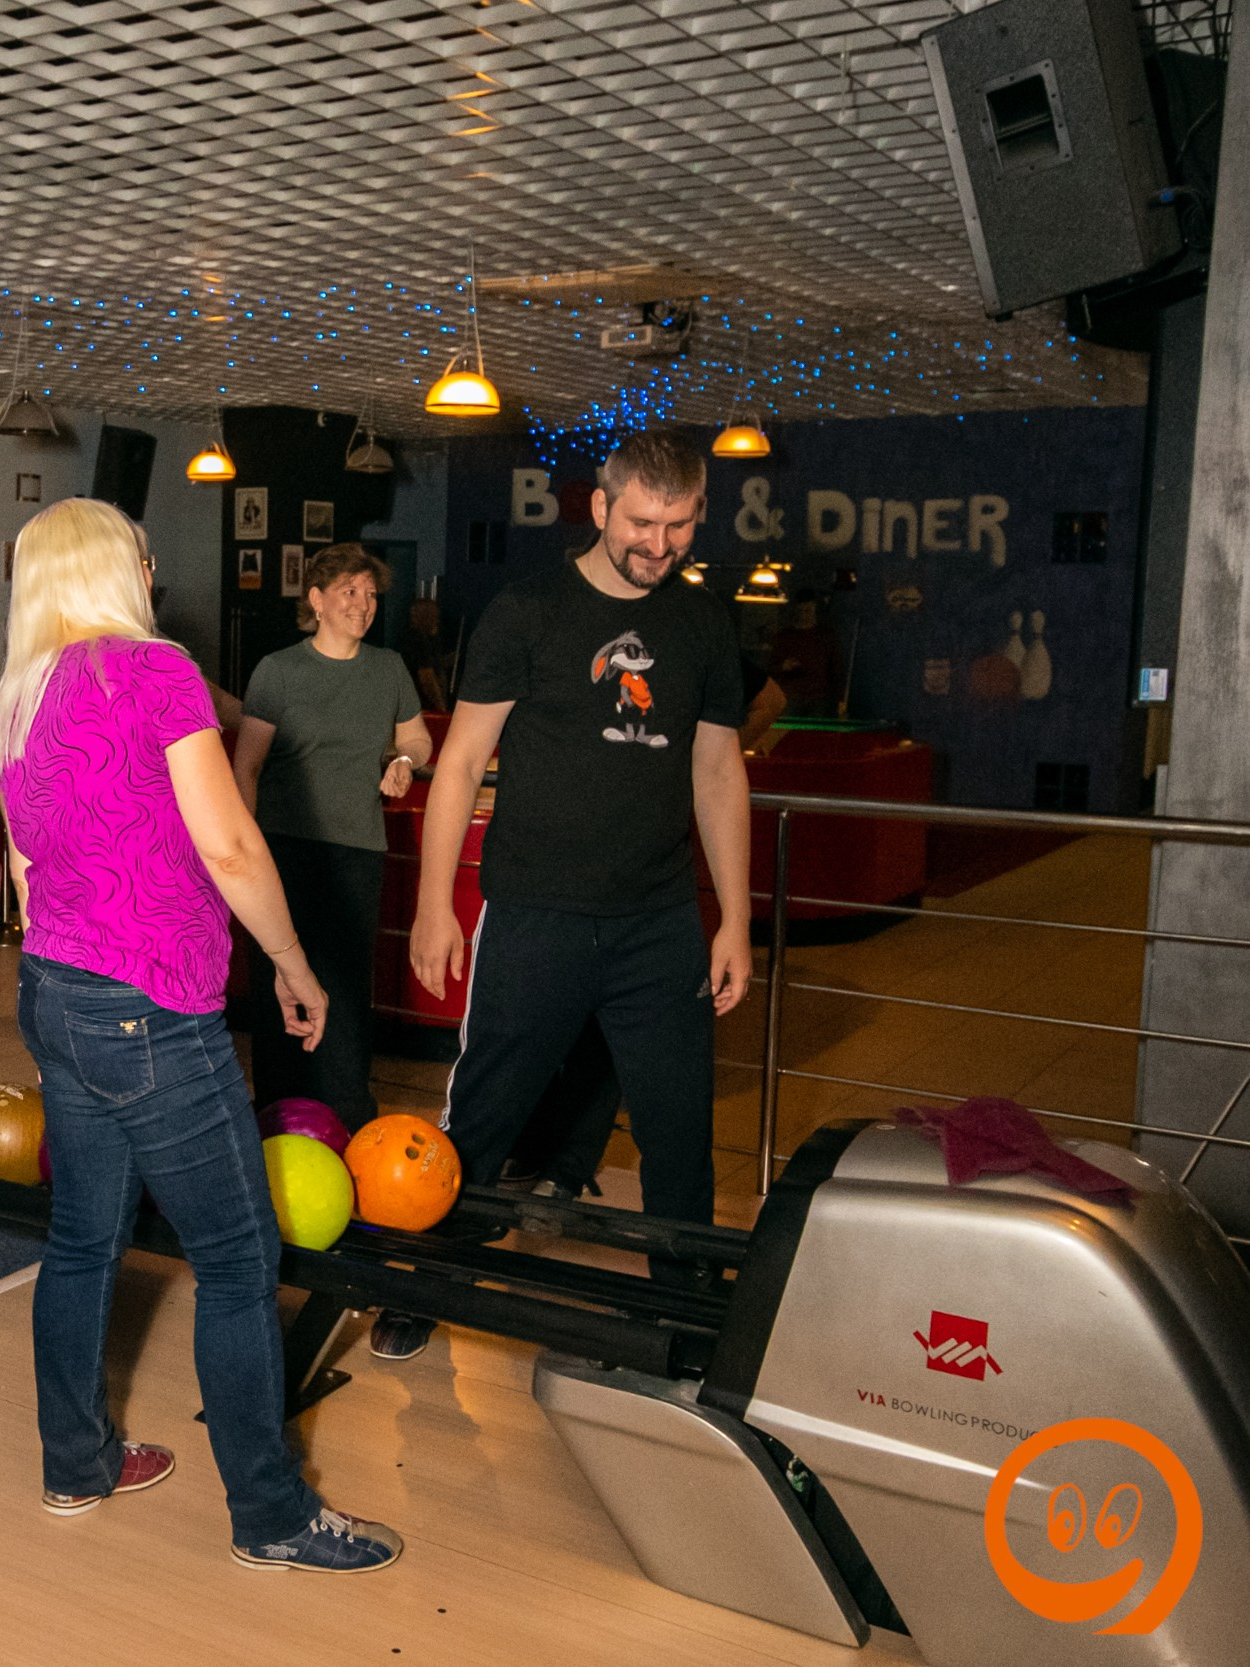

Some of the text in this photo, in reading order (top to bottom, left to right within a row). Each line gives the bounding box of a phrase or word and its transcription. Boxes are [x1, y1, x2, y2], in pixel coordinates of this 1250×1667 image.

[734, 476, 784, 542] &
[857, 1388, 887, 1407] VIA
[891, 1397, 968, 1426] BOWLING
